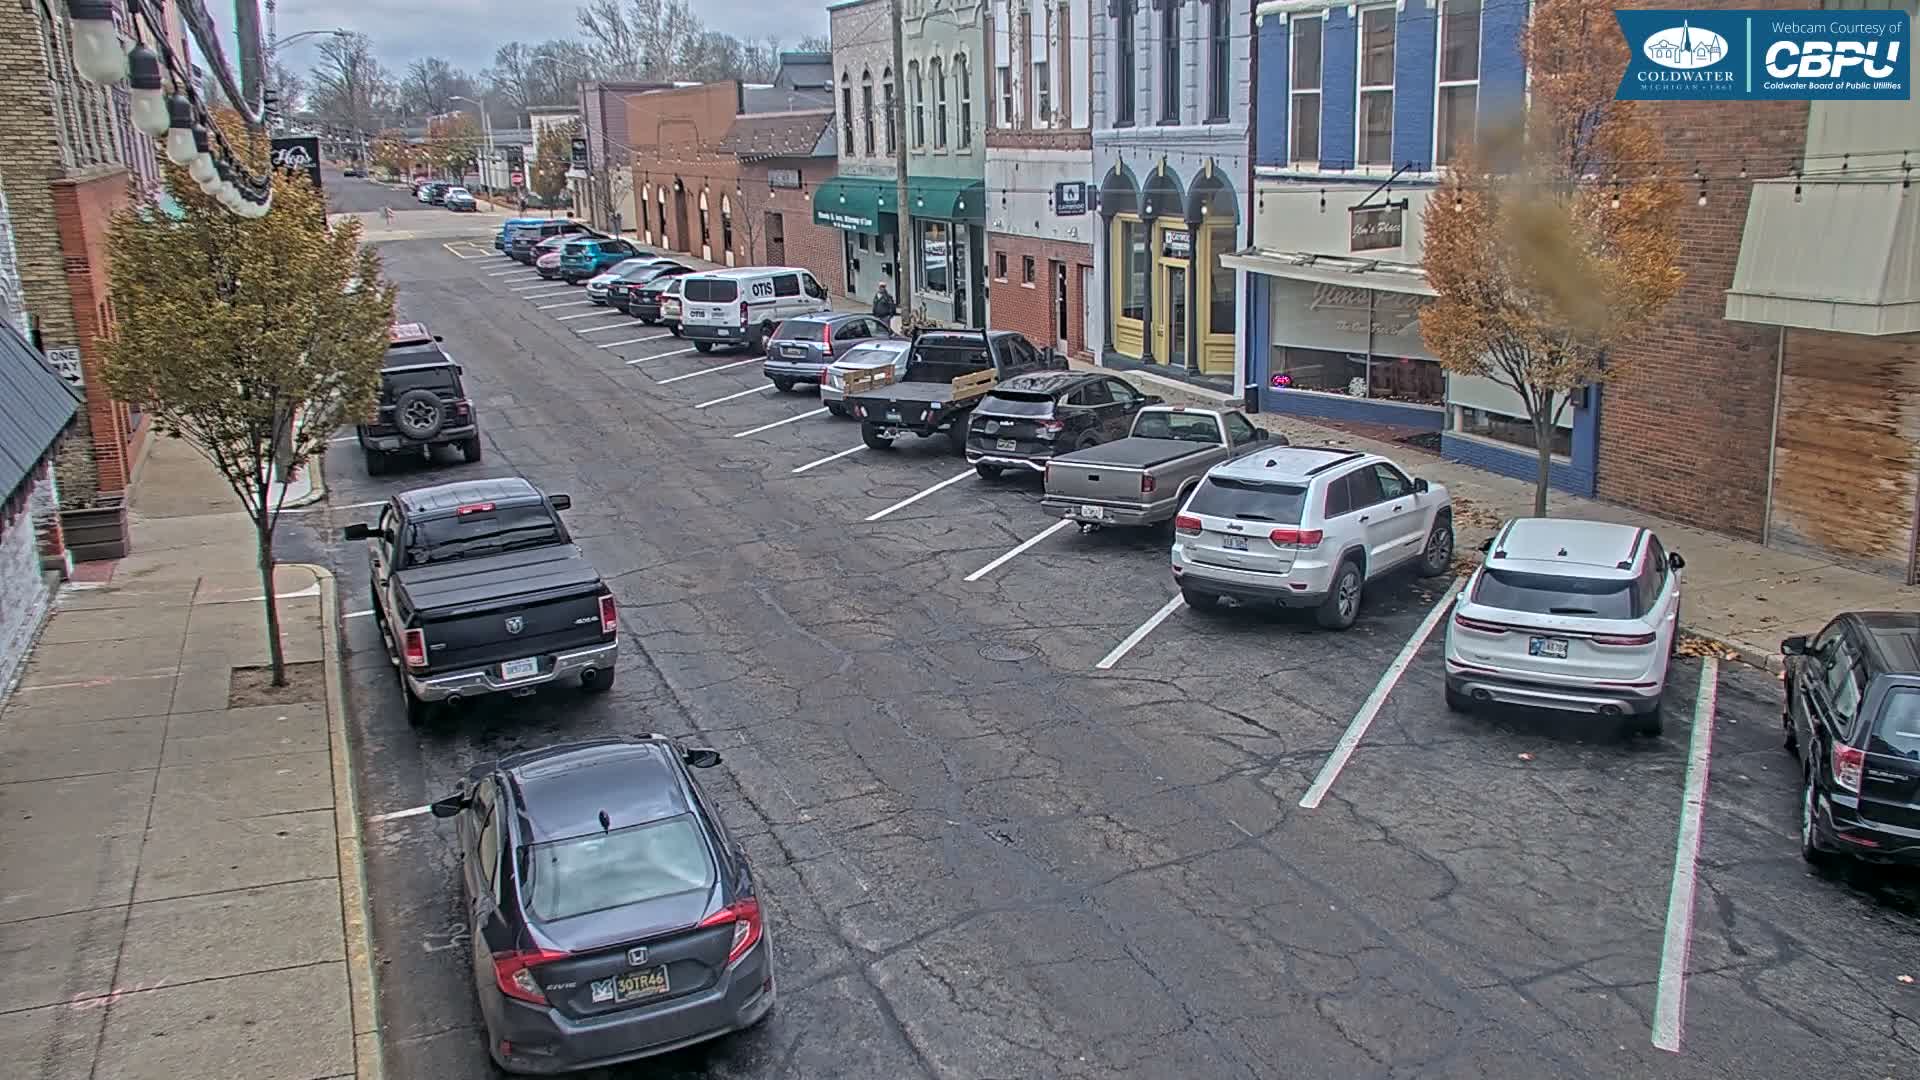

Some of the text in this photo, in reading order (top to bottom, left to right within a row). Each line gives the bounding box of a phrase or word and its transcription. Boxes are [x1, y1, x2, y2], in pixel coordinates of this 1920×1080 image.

[752, 281, 773, 297] OTIS
[689, 310, 706, 319] OTIS
[51, 351, 76, 362] ONE
